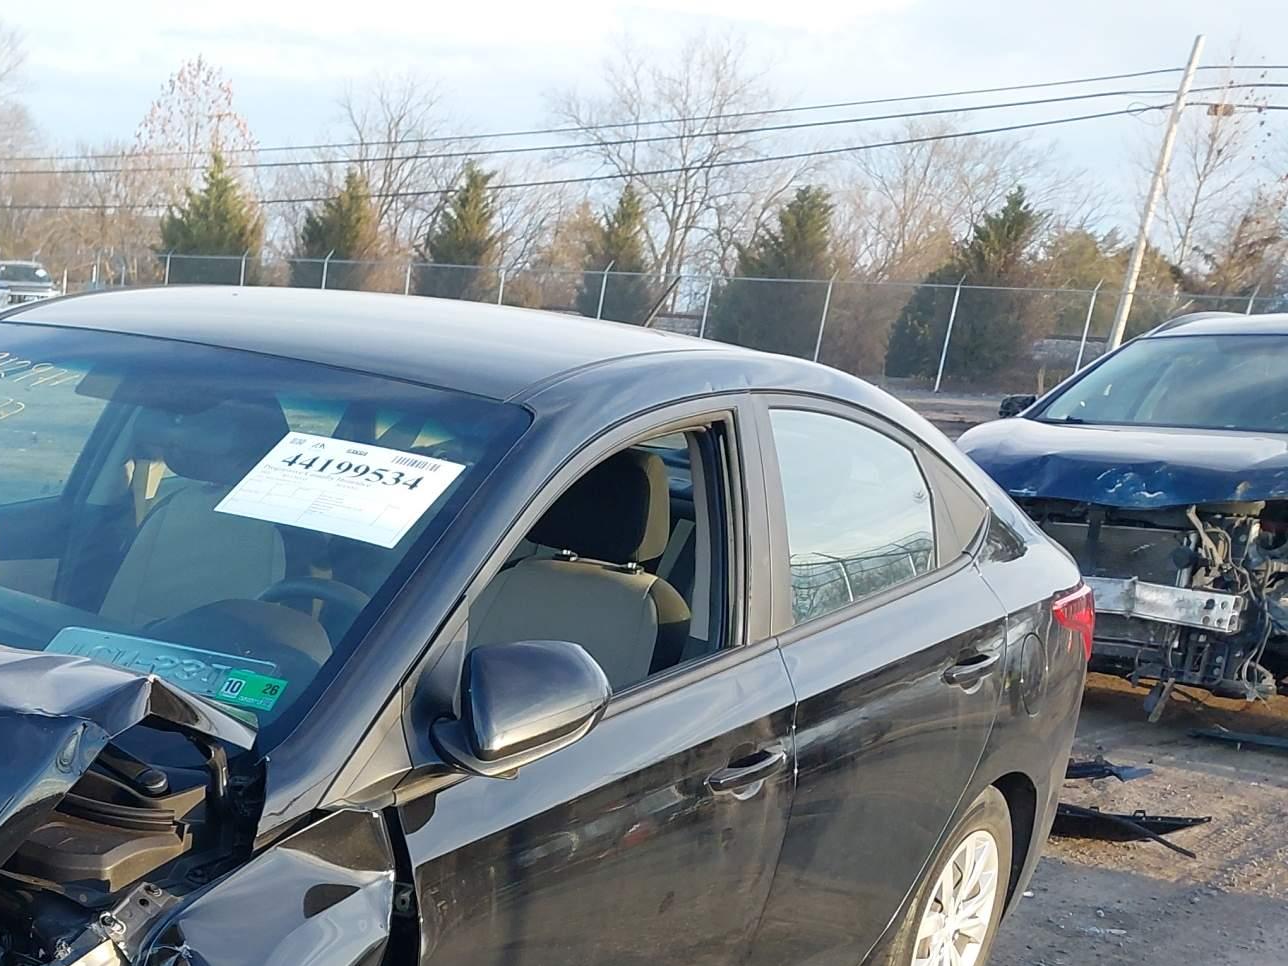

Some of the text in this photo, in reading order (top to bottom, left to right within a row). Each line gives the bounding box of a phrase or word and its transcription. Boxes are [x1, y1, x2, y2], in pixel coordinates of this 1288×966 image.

[282, 452, 425, 491] 44199534
[223, 679, 281, 696] 10 26
